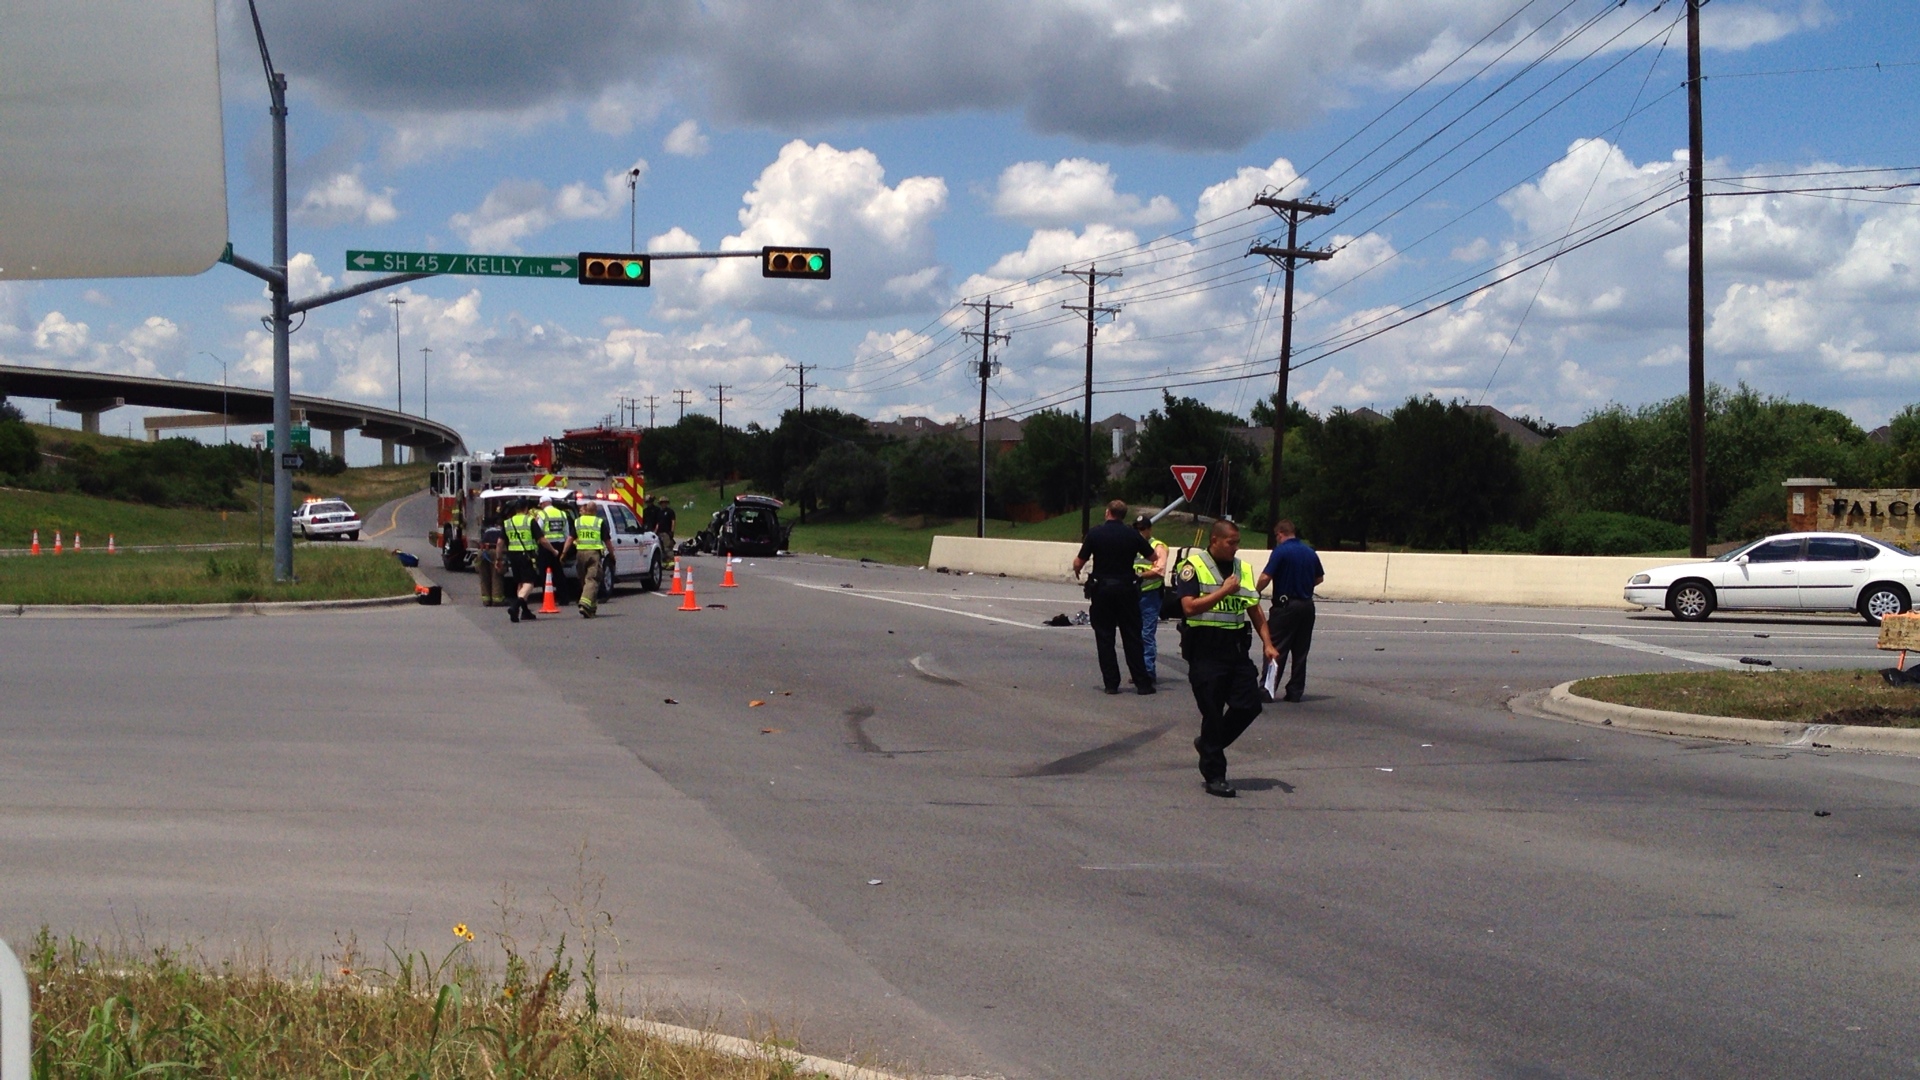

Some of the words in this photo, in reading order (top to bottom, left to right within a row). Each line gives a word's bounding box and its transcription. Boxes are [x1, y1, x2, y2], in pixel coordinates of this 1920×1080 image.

[383, 254, 407, 270] SH
[415, 255, 439, 271] 45
[448, 257, 457, 271] /
[466, 257, 524, 274] KELLY
[529, 266, 544, 275] LN
[579, 531, 595, 539] FIRE
[1218, 598, 1248, 611] OLICE
